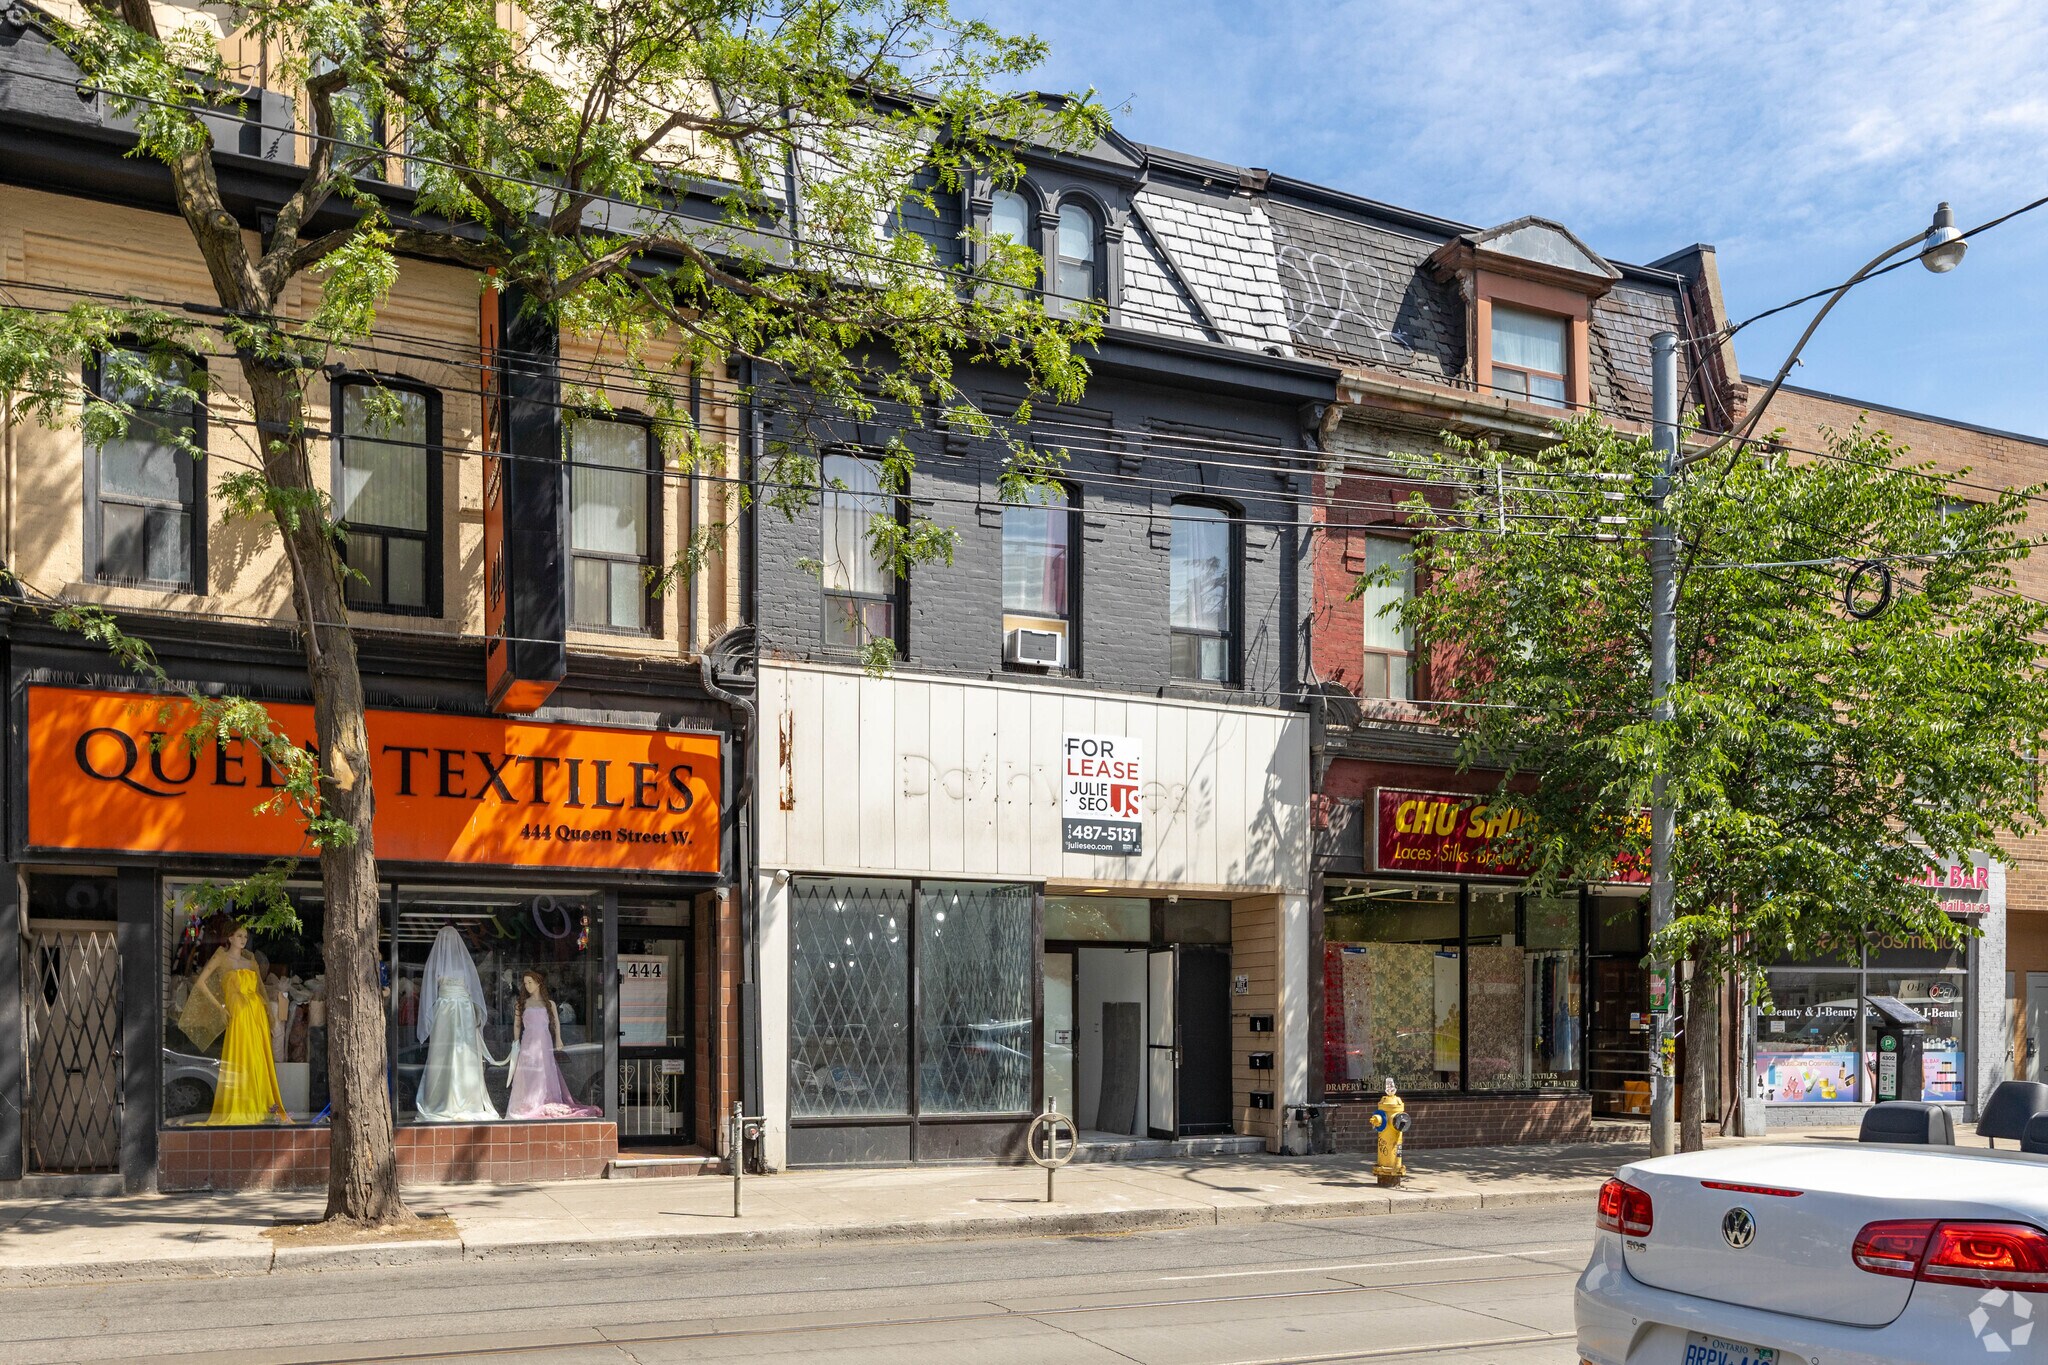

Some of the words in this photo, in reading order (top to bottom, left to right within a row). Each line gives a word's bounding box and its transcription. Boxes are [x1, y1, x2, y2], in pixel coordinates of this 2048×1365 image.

[1067, 738, 1114, 758] FOR
[1067, 758, 1139, 780] LEASE
[382, 745, 694, 813] TEXTILES
[1070, 782, 1108, 796] JULIE
[1079, 797, 1108, 811] SEO
[1395, 800, 1459, 836] CHU
[520, 823, 551, 840] 444
[555, 825, 612, 844] Queen
[616, 828, 667, 844] Street
[671, 831, 693, 845] W.
[1072, 825, 1137, 842] 487-5131
[1395, 842, 1431, 860] Laces
[1440, 843, 1469, 863] Silks
[1950, 865, 1989, 889] BAR
[628, 963, 662, 978] 444
[1931, 985, 1956, 998] OPEN
[1805, 1007, 1814, 1017] &
[1816, 1007, 1858, 1019] J-Beauty
[1923, 1007, 1963, 1019] J-Beauty
[1325, 1083, 1361, 1091] DRAPERY
[1712, 1339, 1749, 1354] ONTARIO
